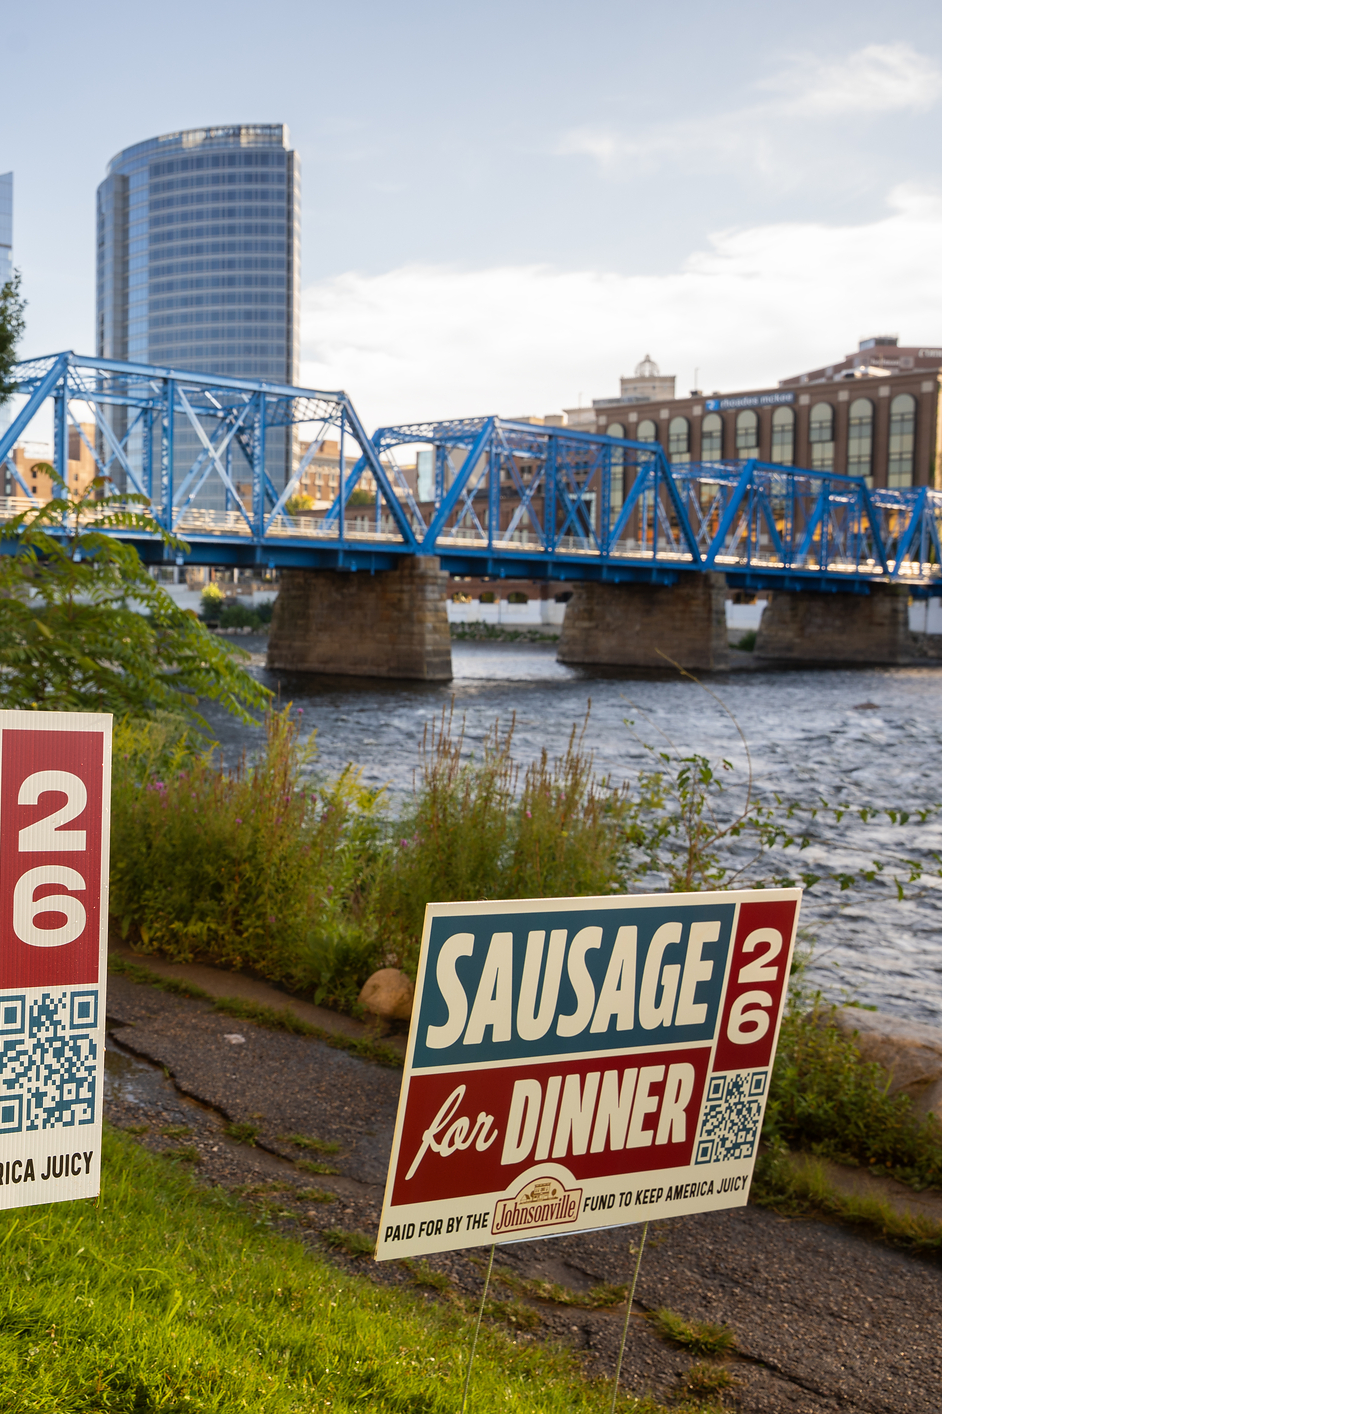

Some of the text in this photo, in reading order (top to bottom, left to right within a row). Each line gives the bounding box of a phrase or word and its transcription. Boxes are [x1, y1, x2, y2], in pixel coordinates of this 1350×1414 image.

[425, 920, 722, 1049] SAUSAGE
[40, 1150, 94, 1181] JUICY
[405, 1062, 696, 1181] for DINNER
[384, 1174, 749, 1243] PAID FOR BY THE Johnsonville FUND TO KEEP AMERICA JUICY
